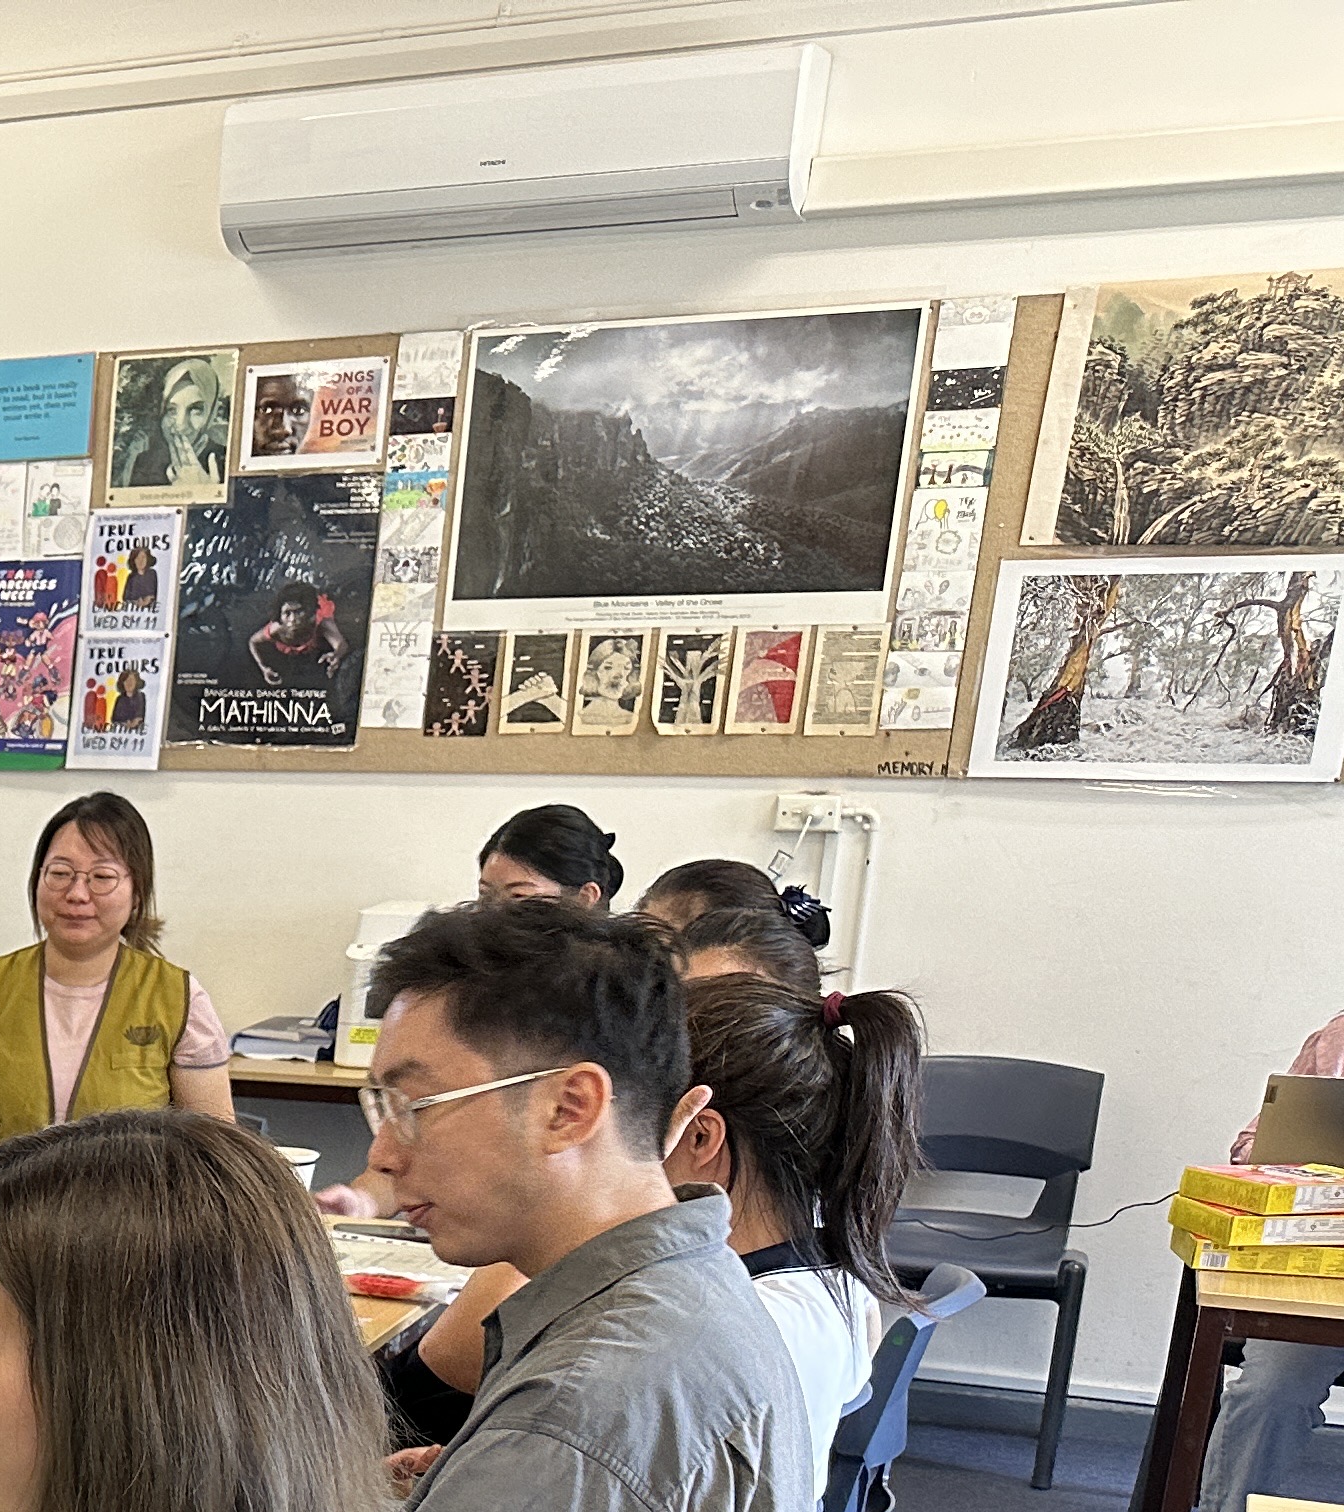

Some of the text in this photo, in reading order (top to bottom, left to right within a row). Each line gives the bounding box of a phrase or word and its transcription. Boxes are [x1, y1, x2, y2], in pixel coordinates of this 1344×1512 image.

[346, 386, 374, 395] OF A
[320, 398, 372, 416] WAR
[319, 416, 370, 438] BOY
[98, 523, 137, 537] TRUE
[104, 534, 170, 554] COLOURS
[0, 590, 35, 601] WEEK
[593, 600, 609, 608] Blue
[93, 615, 118, 630] WED
[89, 646, 125, 660] TRUE
[94, 658, 160, 676] COLOURS
[256, 688, 288, 698] DANCE
[291, 688, 327, 699] THEATRE
[199, 697, 333, 725] MATHINNA
[82, 736, 107, 751] WED
